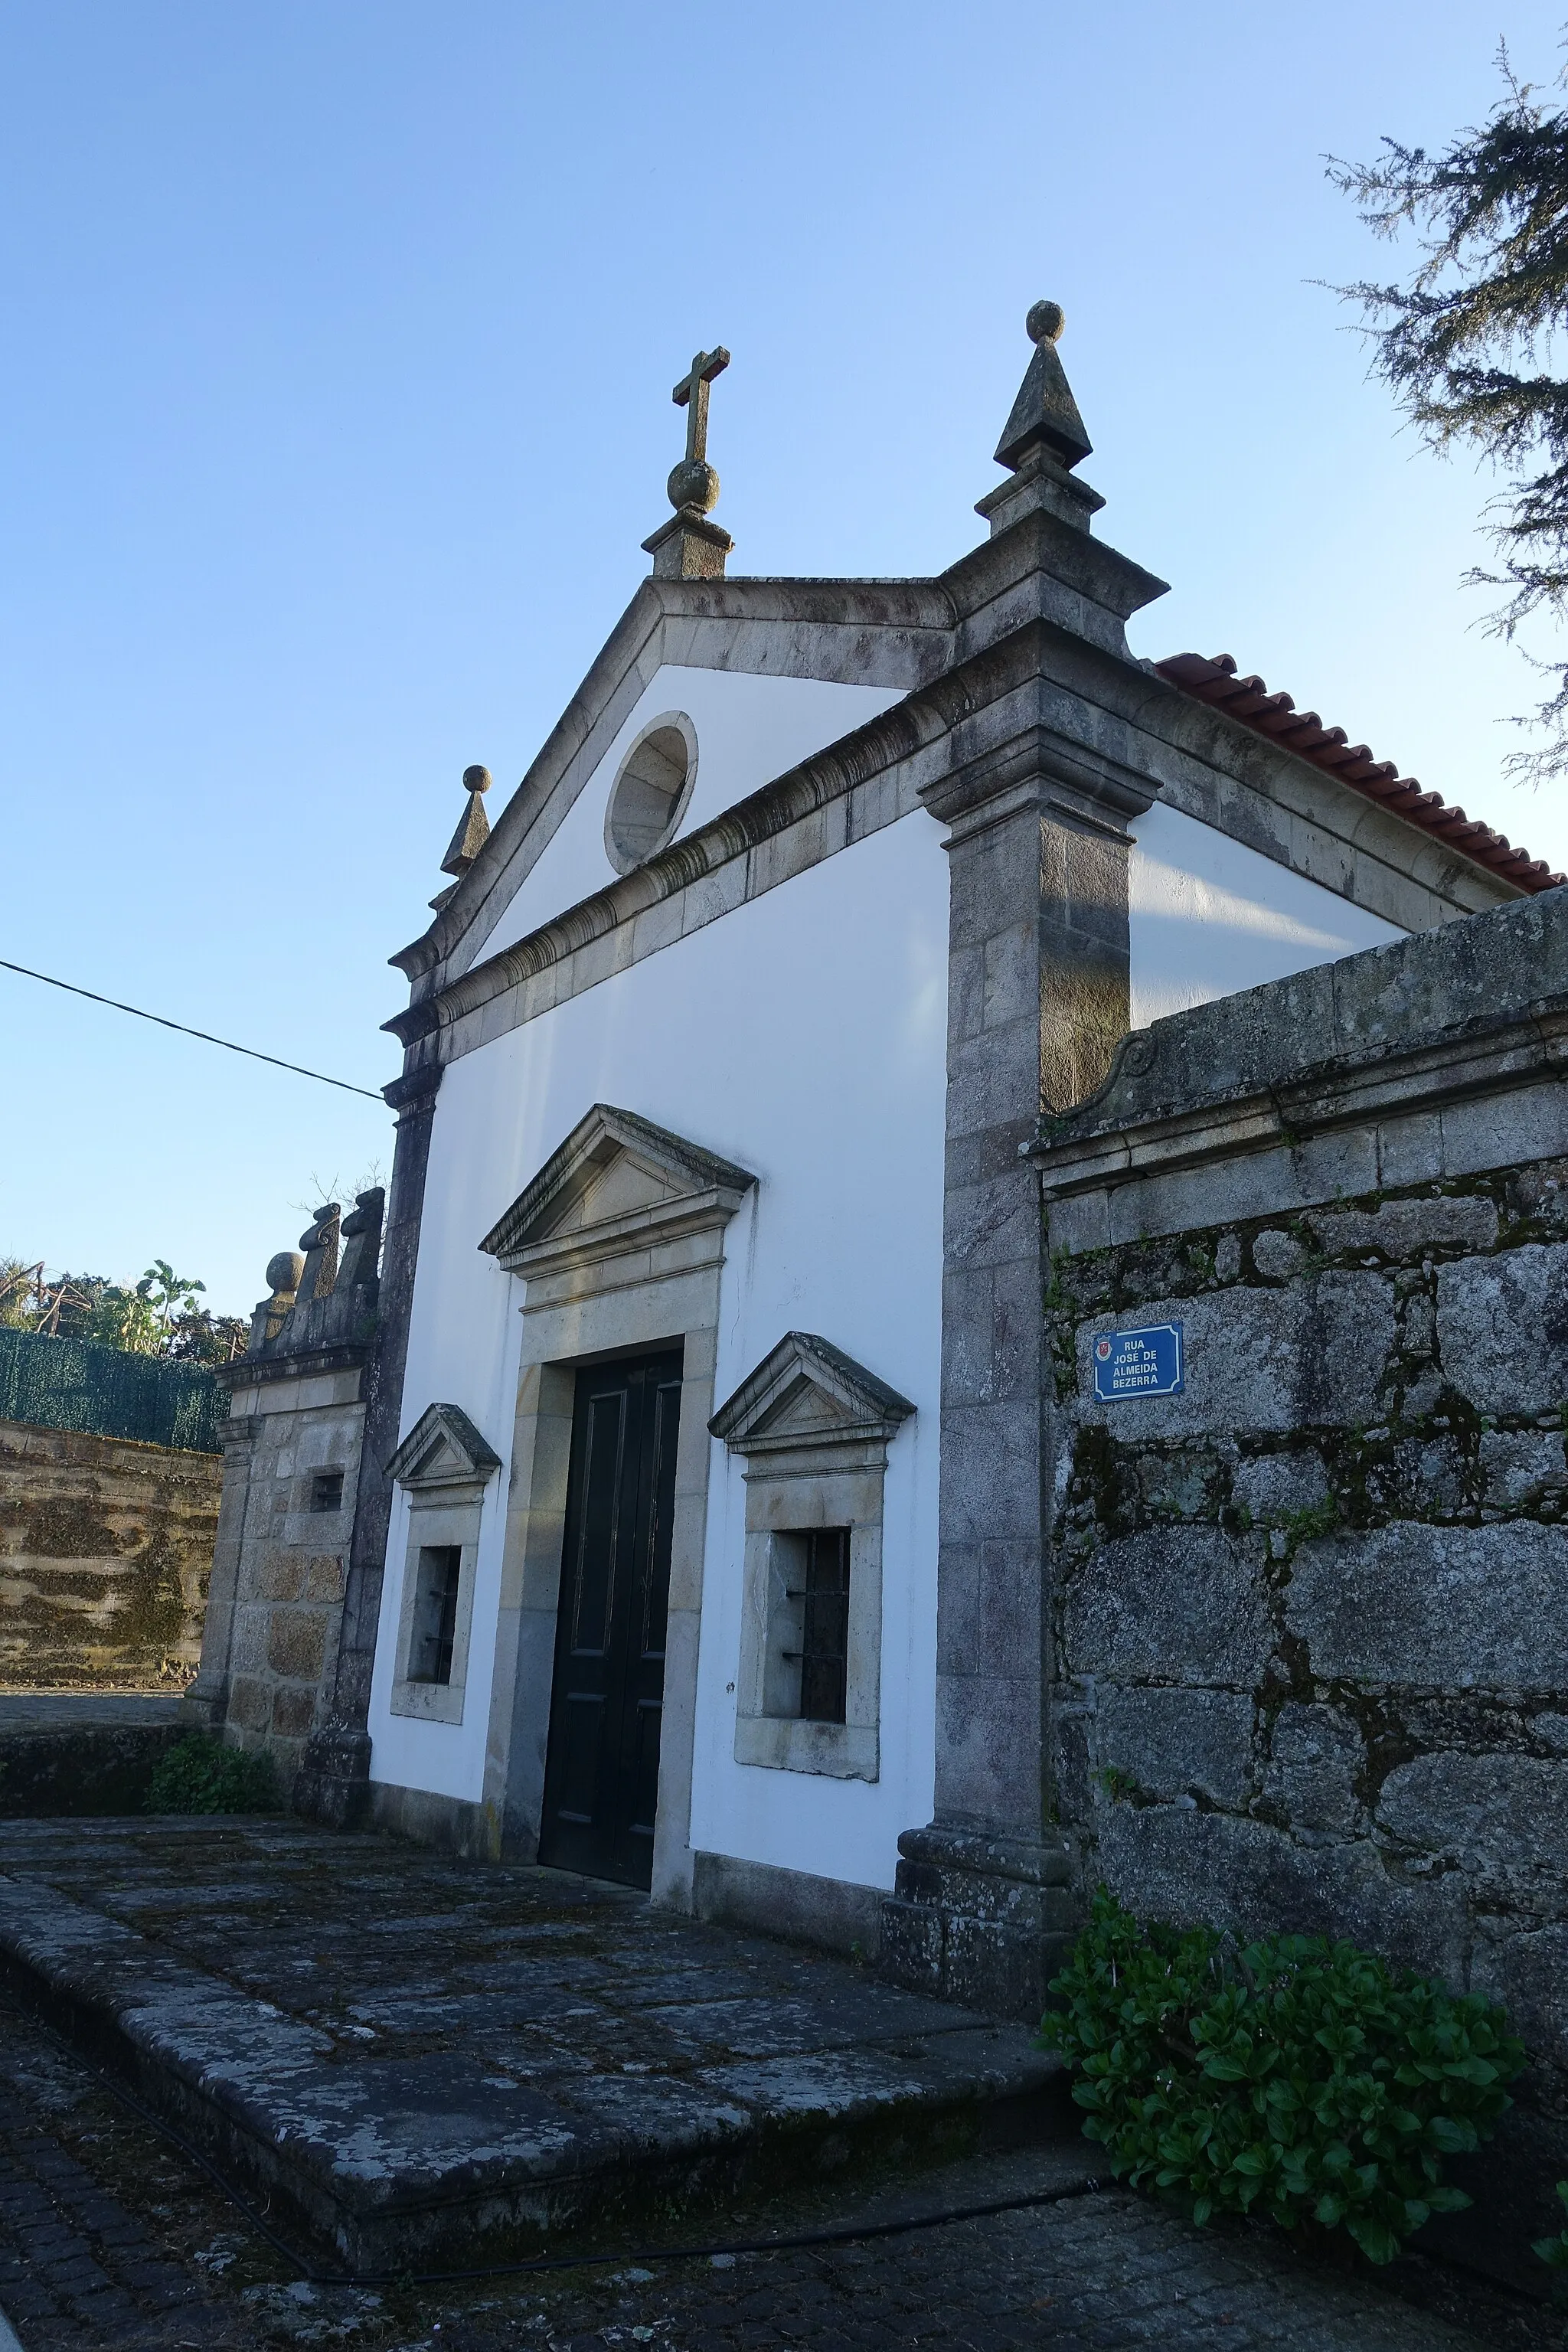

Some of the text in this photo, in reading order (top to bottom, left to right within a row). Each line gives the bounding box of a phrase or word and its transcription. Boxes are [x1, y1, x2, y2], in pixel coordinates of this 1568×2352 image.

[1124, 1340, 1145, 1351] RUA
[1113, 1351, 1157, 1364] JOSÉ DE
[1113, 1363, 1158, 1377] ALMEIDA
[1113, 1375, 1158, 1389] BEZERRA
